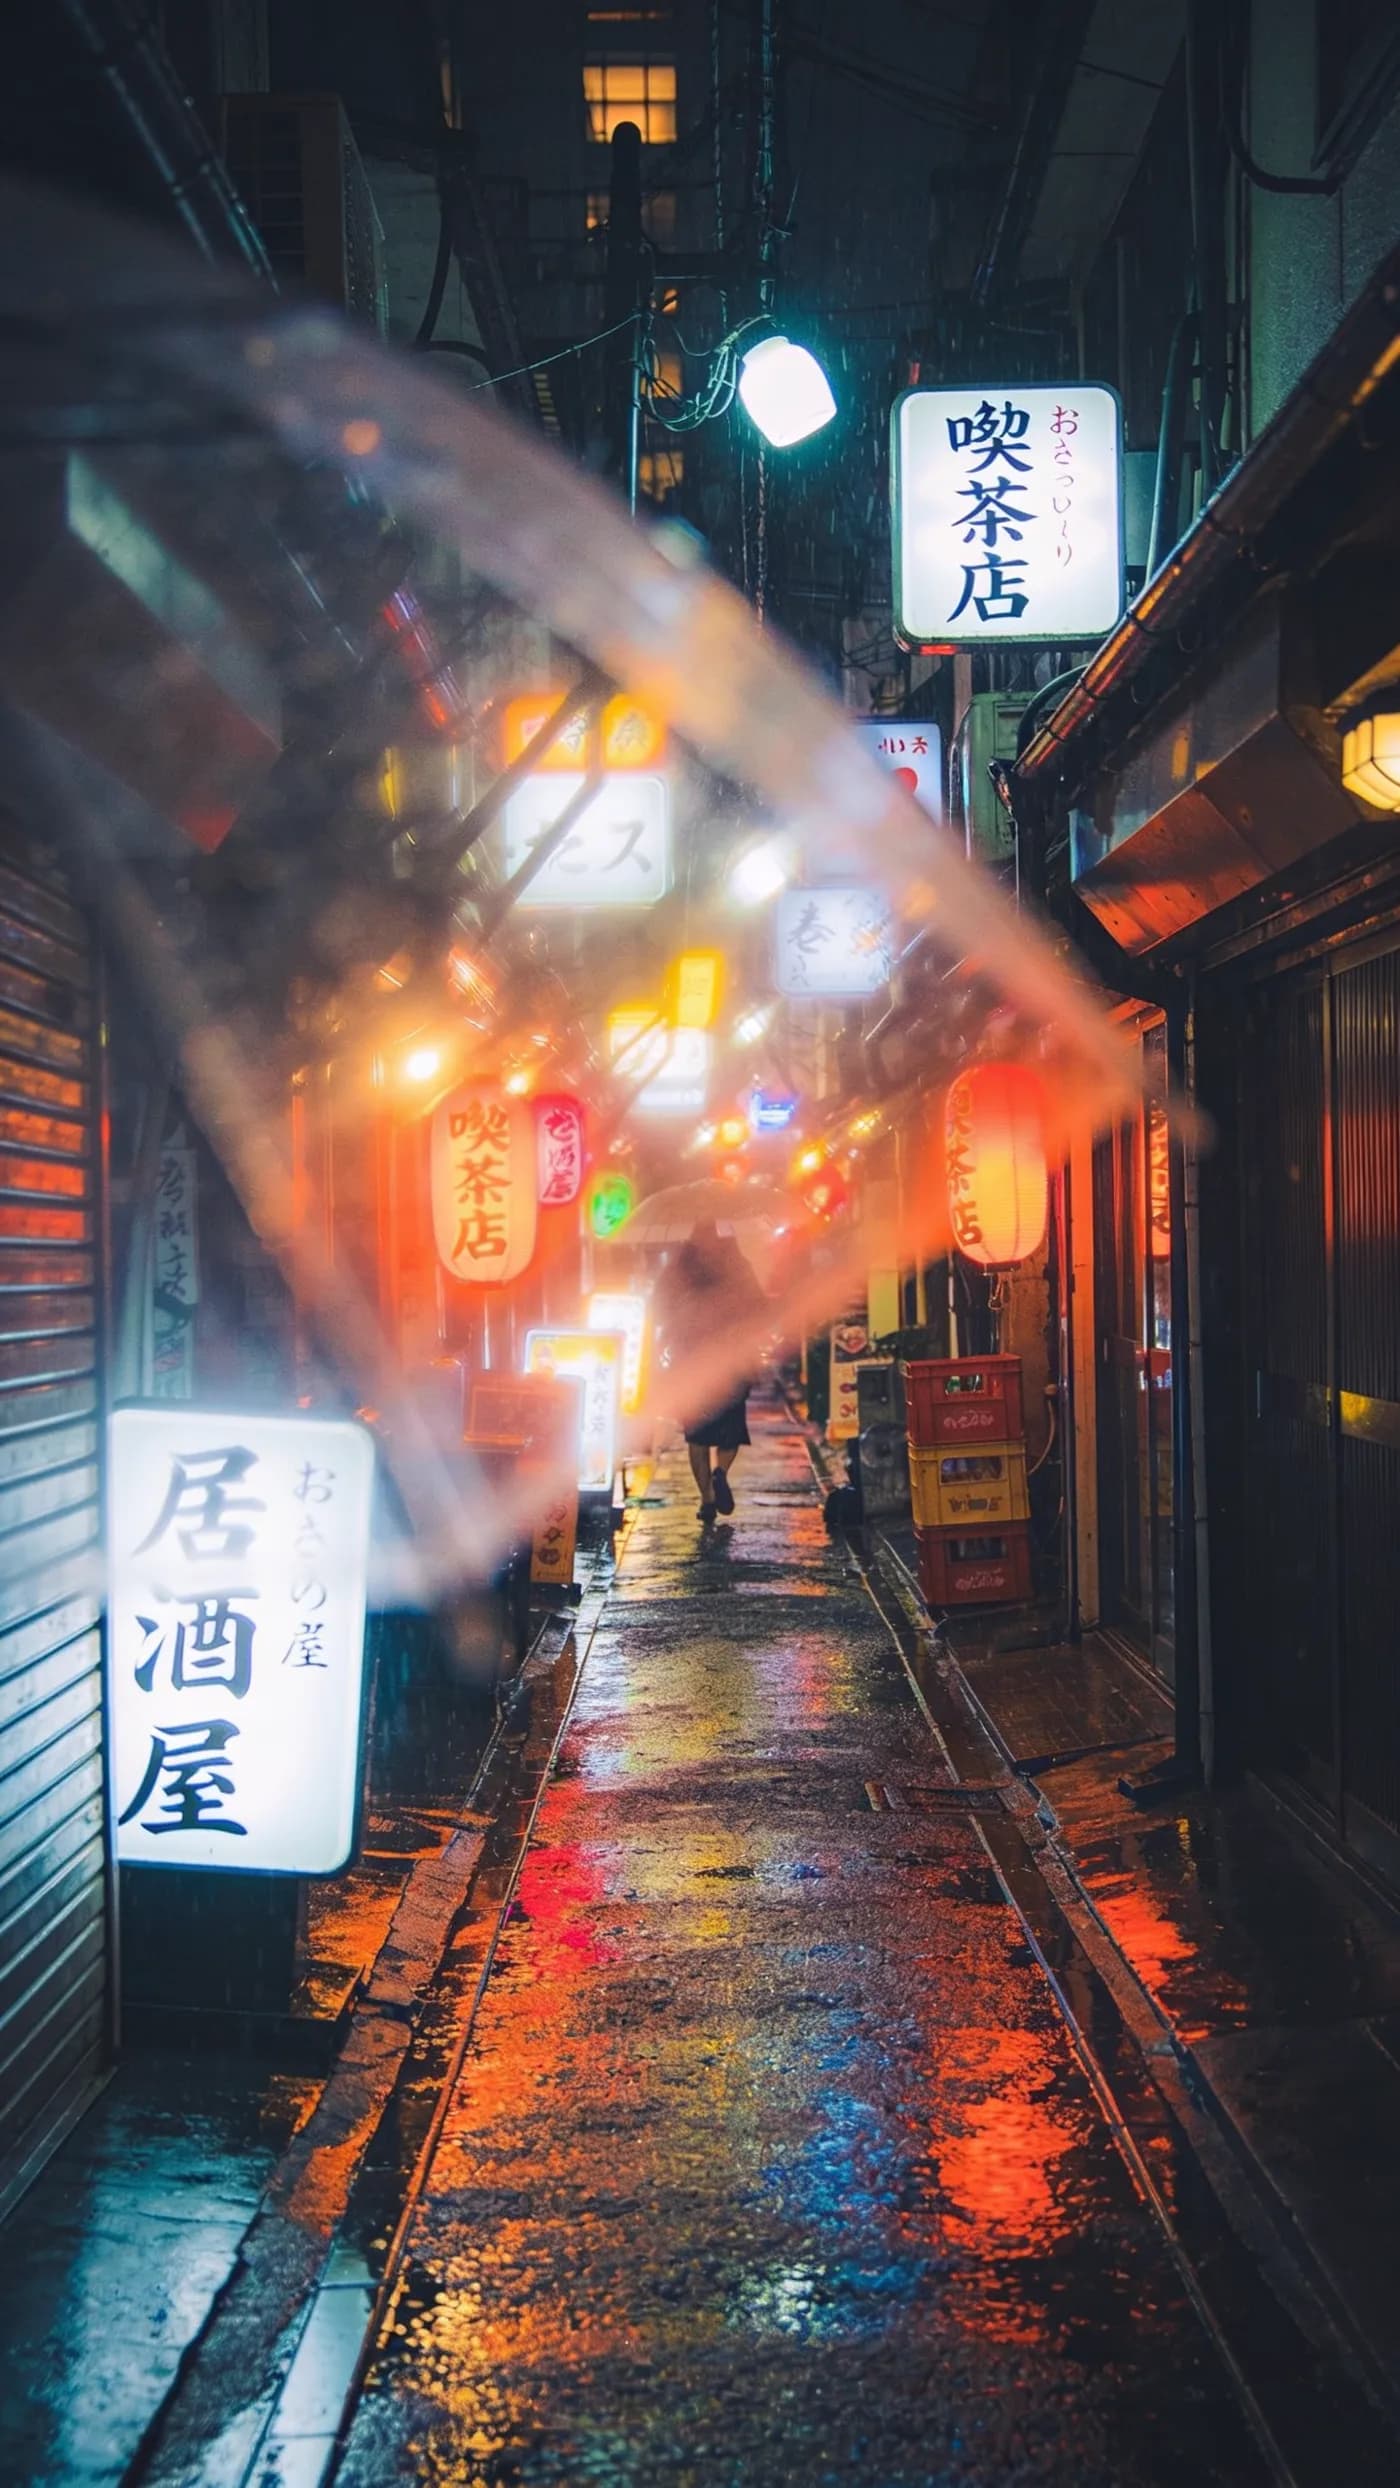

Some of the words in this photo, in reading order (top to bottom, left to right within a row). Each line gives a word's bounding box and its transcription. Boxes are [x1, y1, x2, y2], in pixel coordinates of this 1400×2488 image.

[946, 400, 1038, 623] 喫茶店
[450, 1101, 512, 1262] 喫茶店
[118, 1445, 267, 1837] 居酒屋
